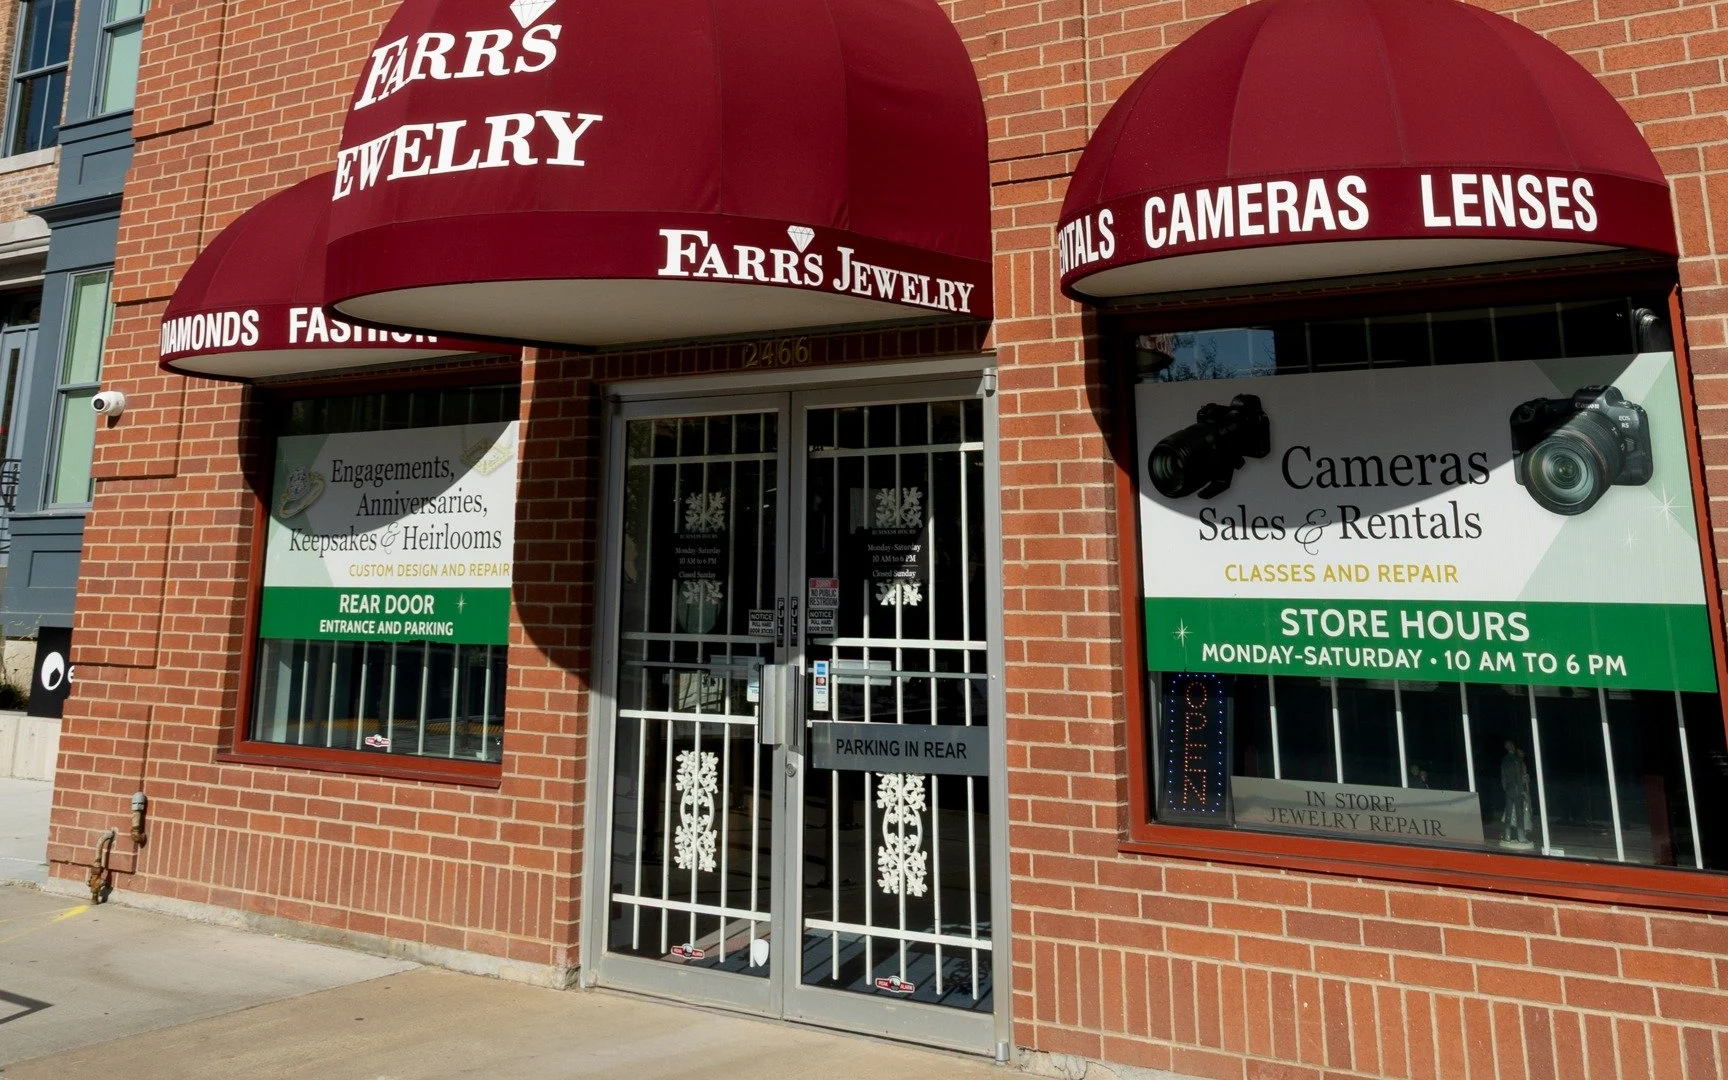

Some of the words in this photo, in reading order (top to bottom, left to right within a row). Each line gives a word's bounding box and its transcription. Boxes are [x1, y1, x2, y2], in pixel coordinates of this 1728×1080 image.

[332, 110, 603, 201] EWELRY
[1144, 175, 1369, 249] CAMERAS
[1420, 173, 1598, 232] LENSES
[833, 246, 974, 313] JEWELRY
[161, 309, 259, 356] DIAMONDS
[745, 336, 808, 368] 2466
[331, 456, 455, 488] Engagements,
[1281, 445, 1490, 490] Cameras
[356, 488, 488, 517] Anniversaries,
[289, 522, 378, 558] Keepsakes
[380, 521, 401, 554] &
[402, 522, 502, 551] Heirlooms
[1199, 504, 1286, 541] Sales
[1294, 508, 1332, 556] &
[1337, 500, 1483, 540] Rentals
[349, 563, 394, 577] CUSTOM
[397, 563, 438, 577] DESIGN
[441, 563, 466, 577] AND
[469, 563, 510, 577] REPAIR
[1224, 564, 1316, 583] CLASSES
[1323, 564, 1370, 583] AND
[1378, 564, 1459, 583] REPAIR
[339, 594, 380, 614] REAR
[385, 594, 434, 615] DOOR
[319, 619, 375, 634] ENTRANCE
[377, 620, 402, 635] AND
[404, 621, 454, 636] PARKING
[1280, 608, 1390, 638] STORE
[1400, 609, 1531, 642] HOURS
[1202, 643, 1423, 669] MONDAY-SATURDAY
[1444, 650, 1471, 671] 10
[1479, 651, 1516, 672] AM
[1522, 652, 1558, 674] TO
[1566, 654, 1580, 675] 6
[1588, 654, 1627, 677] PM
[836, 739, 900, 757] PARKING
[905, 740, 919, 757] IN
[924, 741, 967, 759] REAR
[1183, 681, 1208, 805] OPEN
[1305, 790, 1326, 807] IN
[1335, 792, 1397, 813] STORE
[1266, 807, 1360, 830] JEWELRY
[1369, 815, 1446, 837] REPAIR
